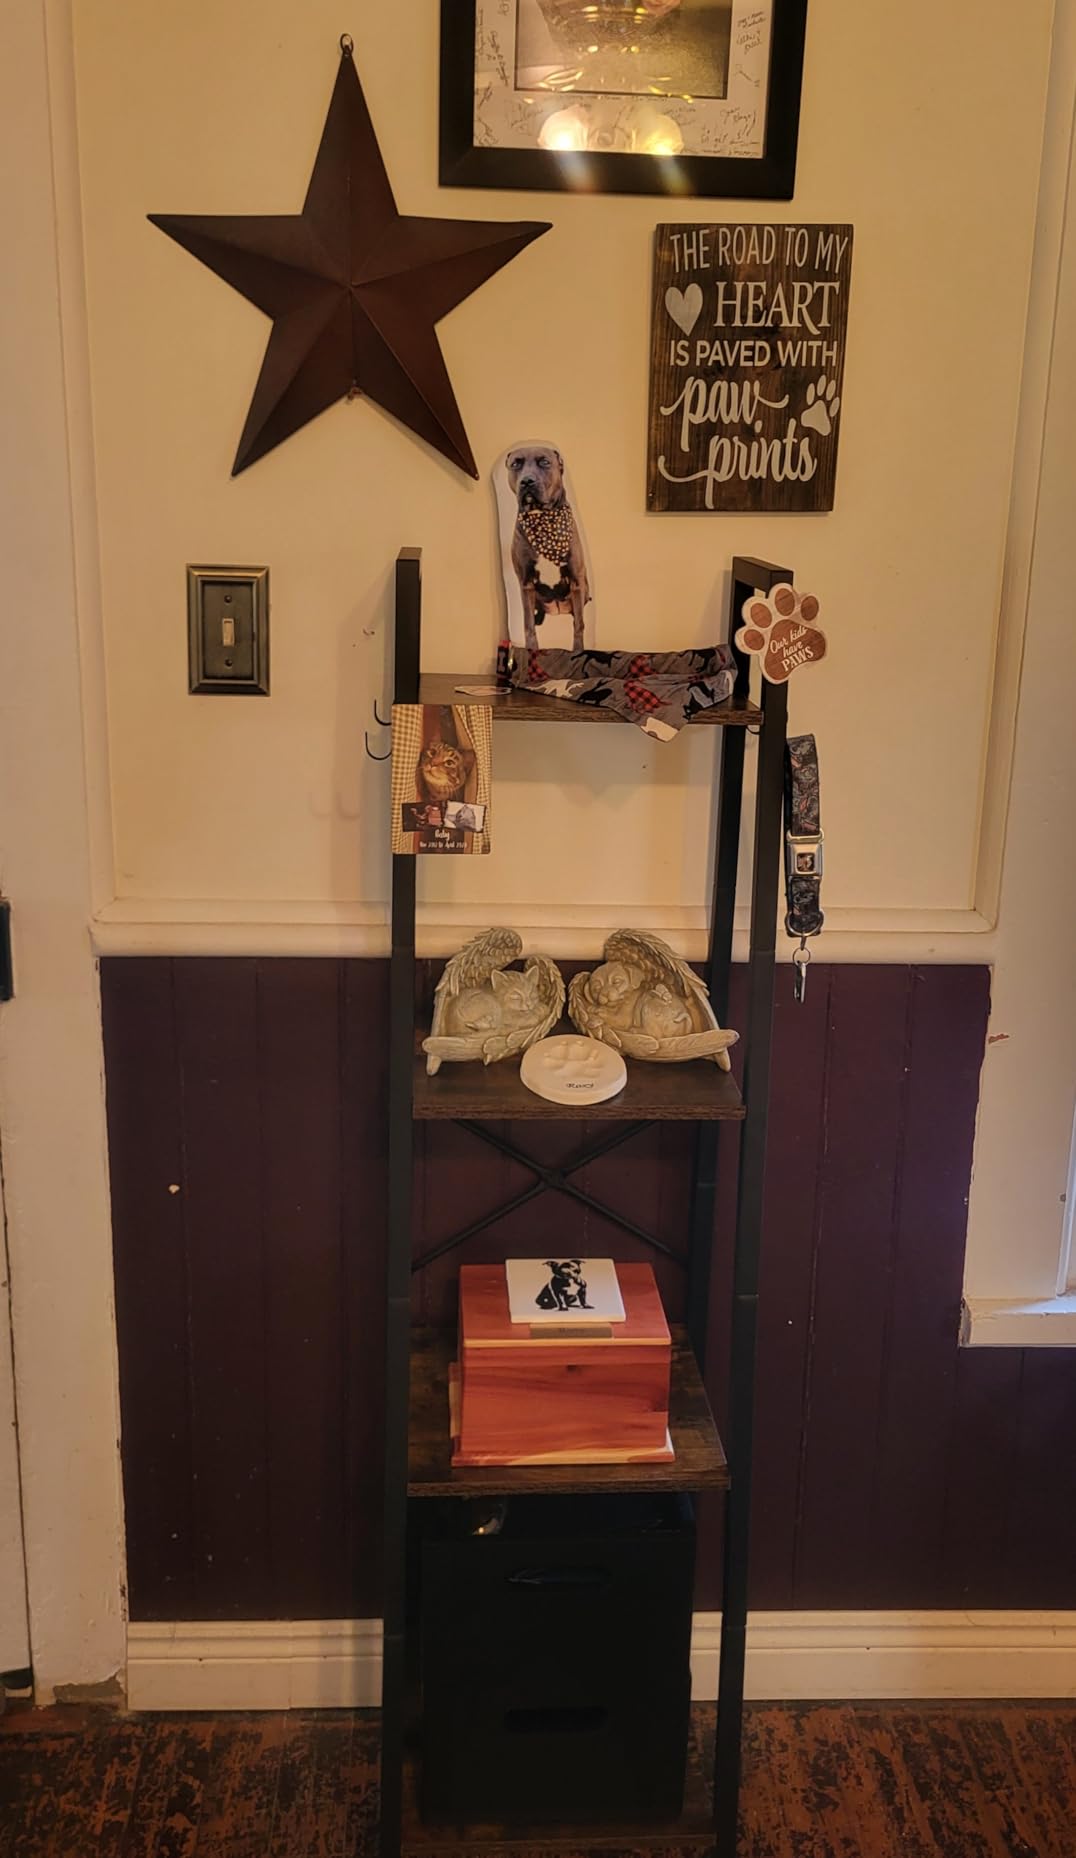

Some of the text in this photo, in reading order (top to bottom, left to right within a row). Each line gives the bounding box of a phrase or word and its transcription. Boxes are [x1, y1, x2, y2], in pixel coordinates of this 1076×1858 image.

[670, 226, 848, 274] THE ROAD TO MY
[713, 281, 840, 335] HEART
[670, 340, 838, 367] IS PAVED WITH
[660, 376, 789, 452] paw
[657, 418, 818, 509] prints
[770, 625, 809, 654] Our kids
[782, 641, 804, 658] have
[781, 646, 814, 672] PAWS
